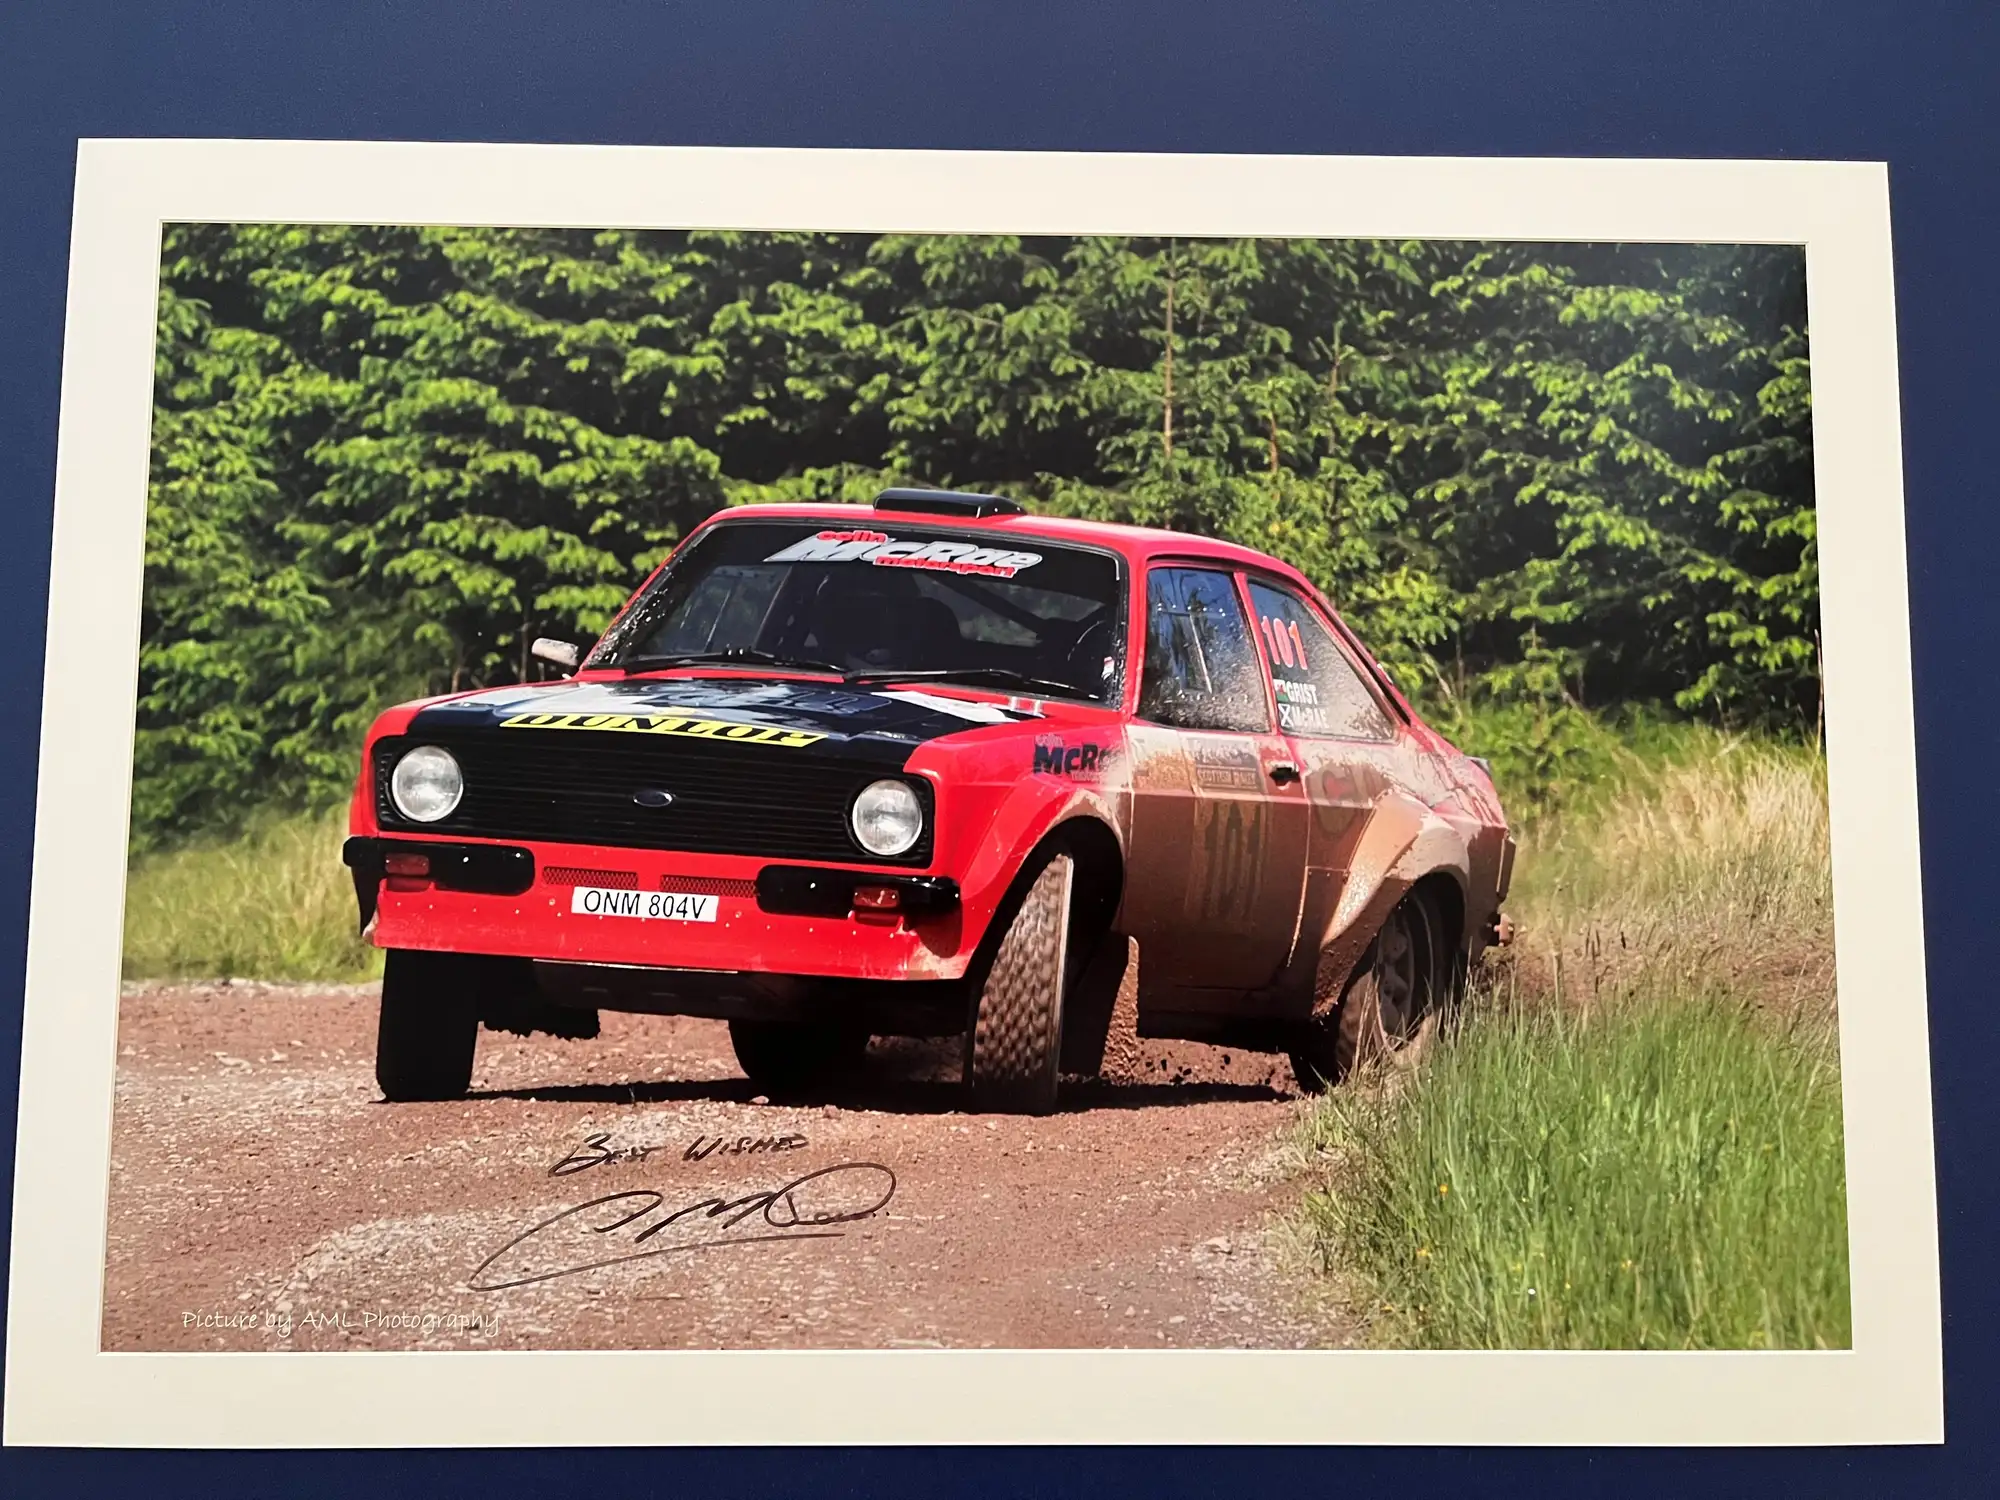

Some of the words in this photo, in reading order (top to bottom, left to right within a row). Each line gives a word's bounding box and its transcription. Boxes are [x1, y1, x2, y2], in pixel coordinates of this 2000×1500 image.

[1260, 615, 1308, 671] 101
[1286, 681, 1318, 705] GRIST
[506, 713, 820, 743] DUNLOP
[583, 889, 641, 916] ONM
[648, 893, 707, 919] 804V
